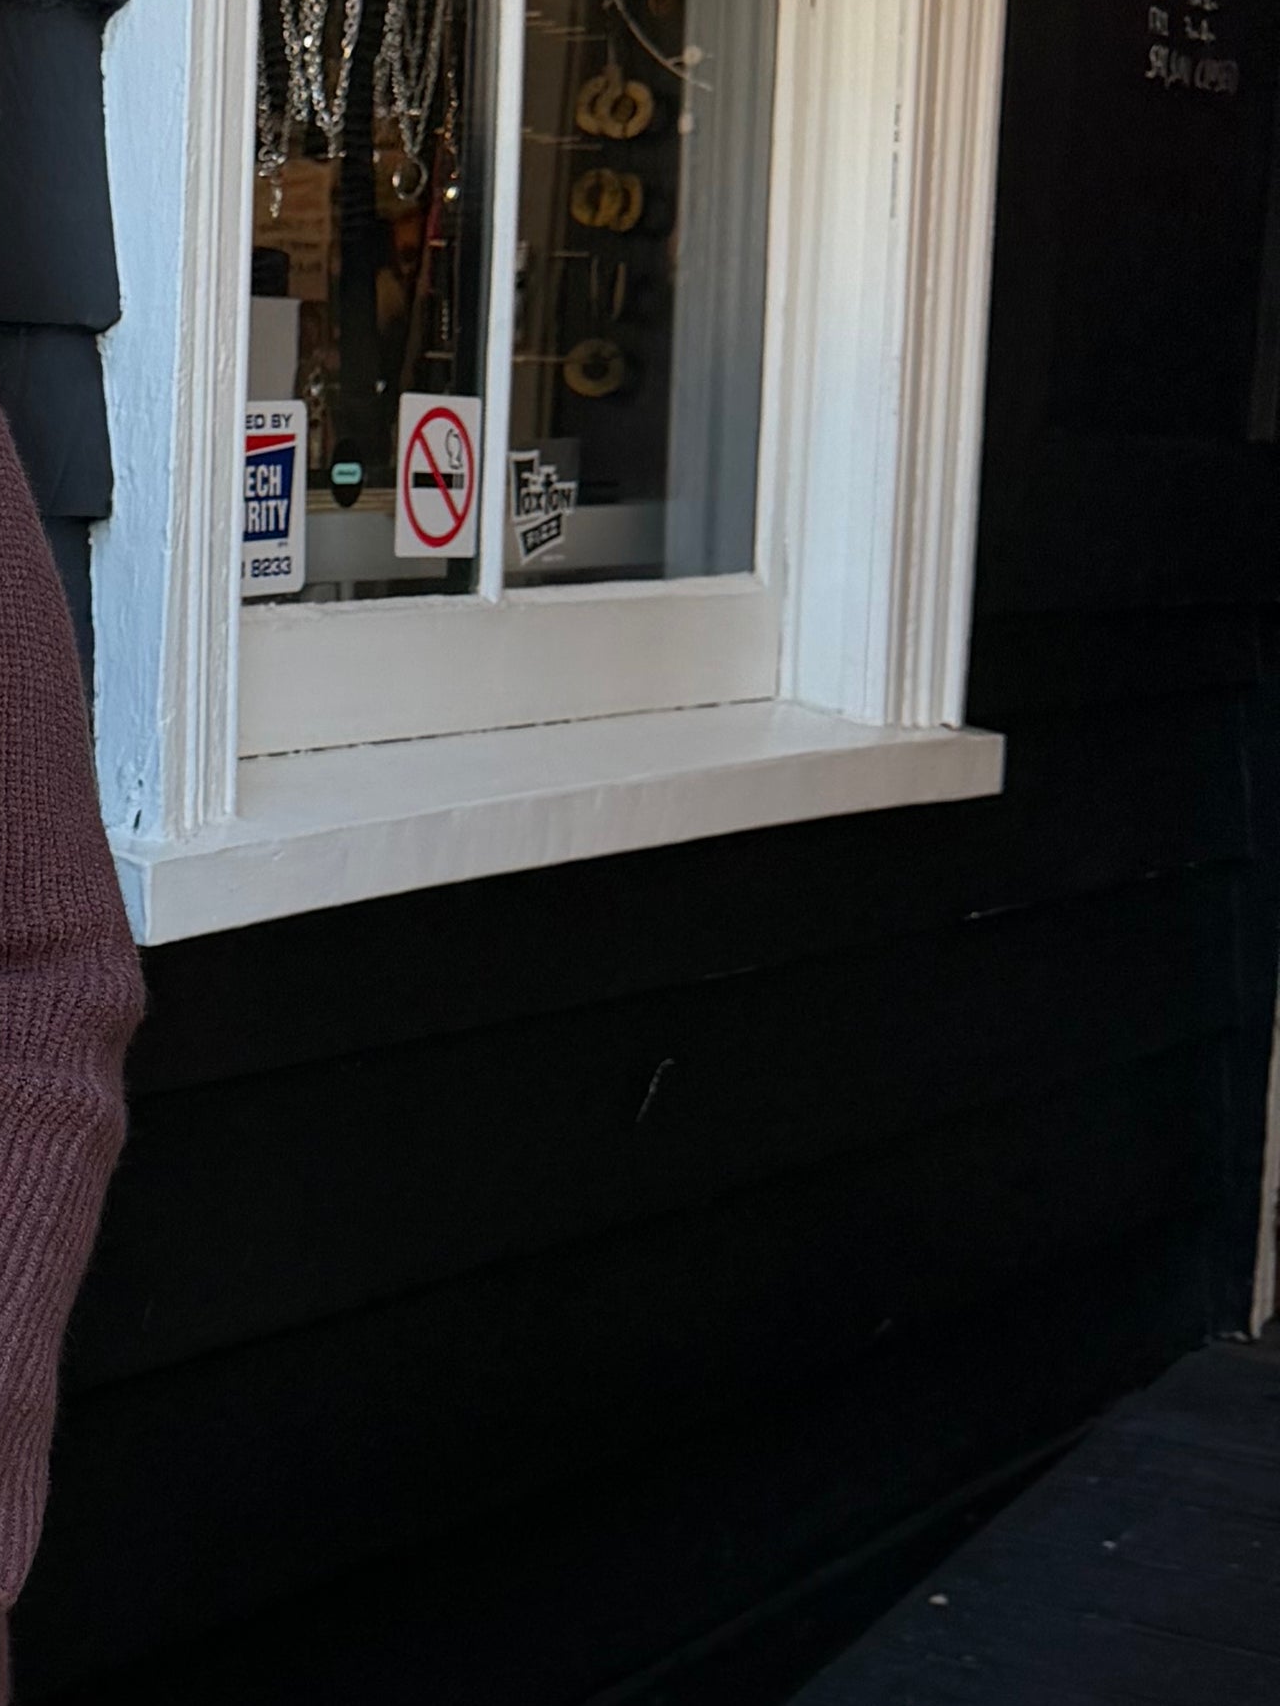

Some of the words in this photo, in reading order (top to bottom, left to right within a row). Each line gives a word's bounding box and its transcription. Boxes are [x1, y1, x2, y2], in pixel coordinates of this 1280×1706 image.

[271, 413, 293, 429] BY
[245, 464, 283, 498] ECH
[244, 499, 289, 534] RITY
[251, 555, 292, 578] 8233
